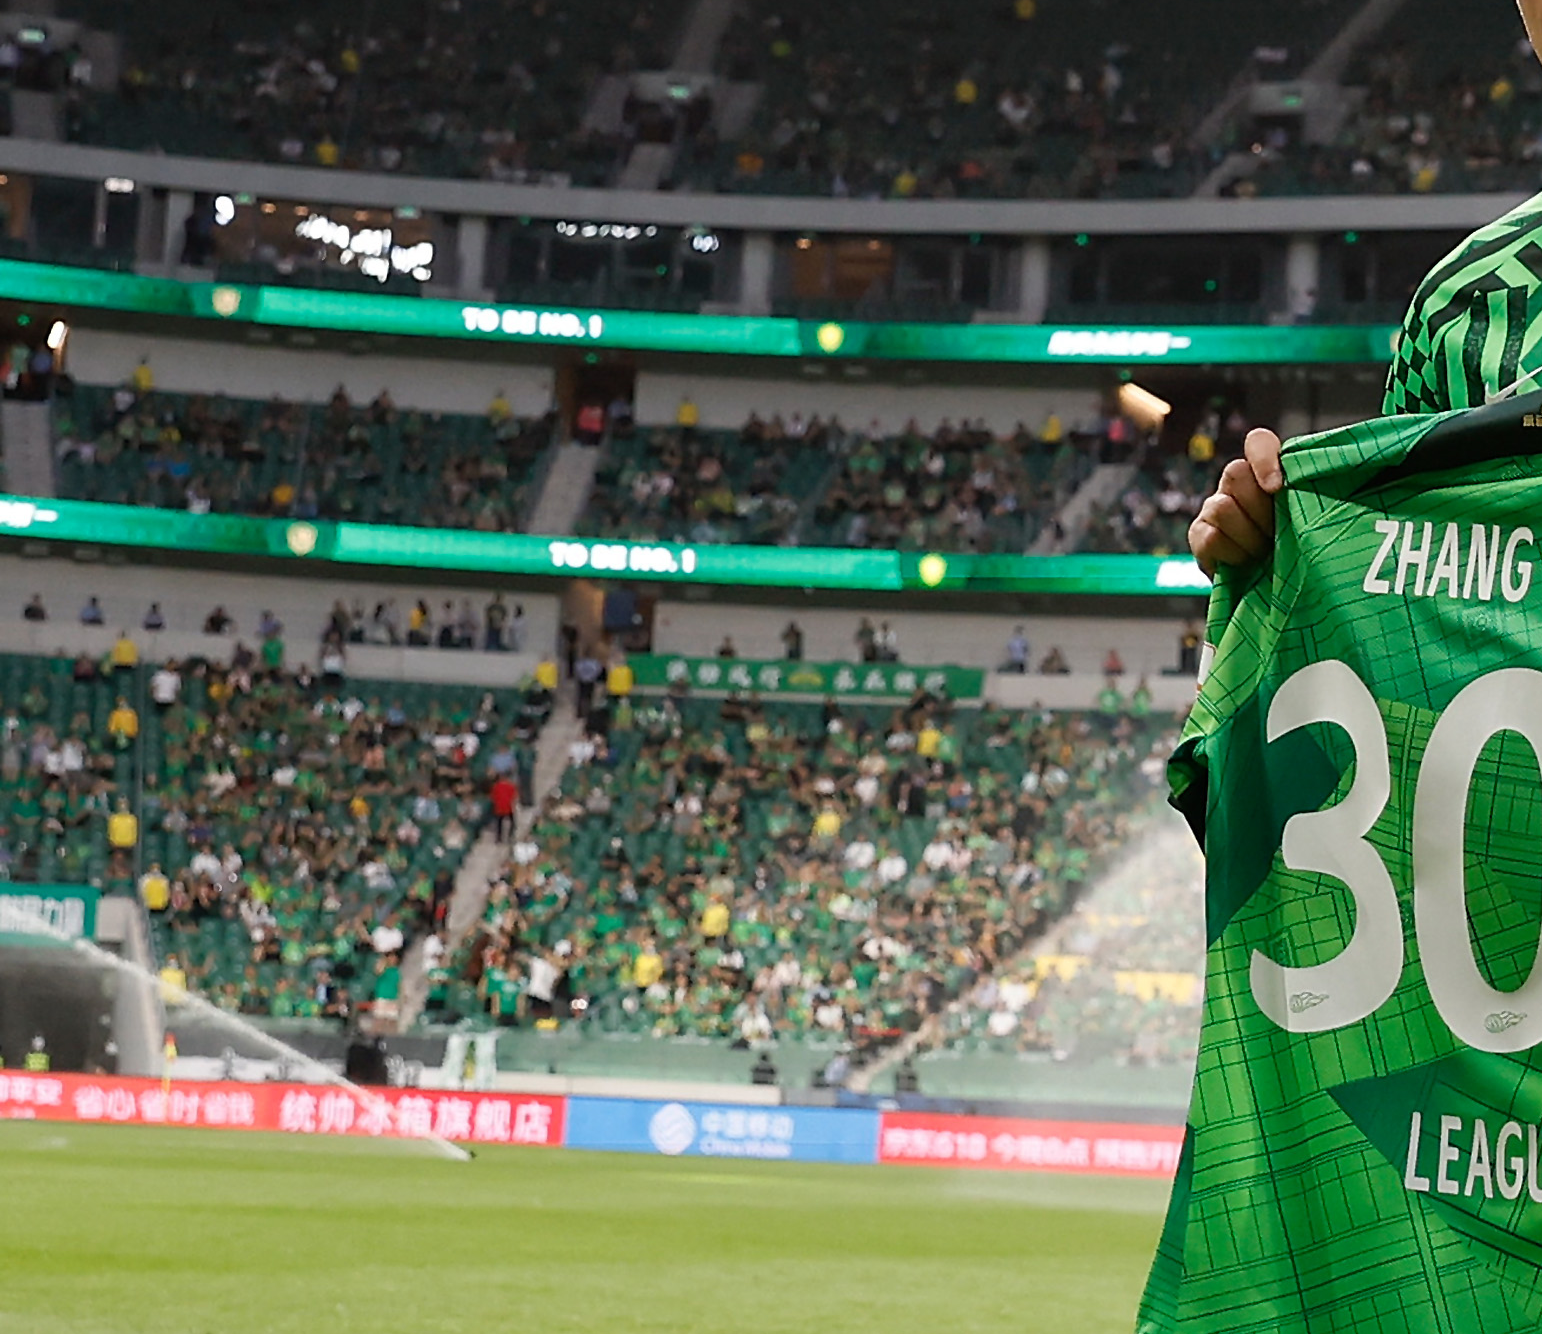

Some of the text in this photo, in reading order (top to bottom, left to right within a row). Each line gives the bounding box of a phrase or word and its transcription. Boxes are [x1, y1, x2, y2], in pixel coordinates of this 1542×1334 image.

[462, 307, 499, 332] TO
[502, 310, 537, 334] BE
[549, 541, 588, 567] TO
[590, 544, 628, 570] BE
[1363, 519, 1534, 603] ZHANG
[279, 1089, 553, 1144] 统帅冰箱旗舰店
